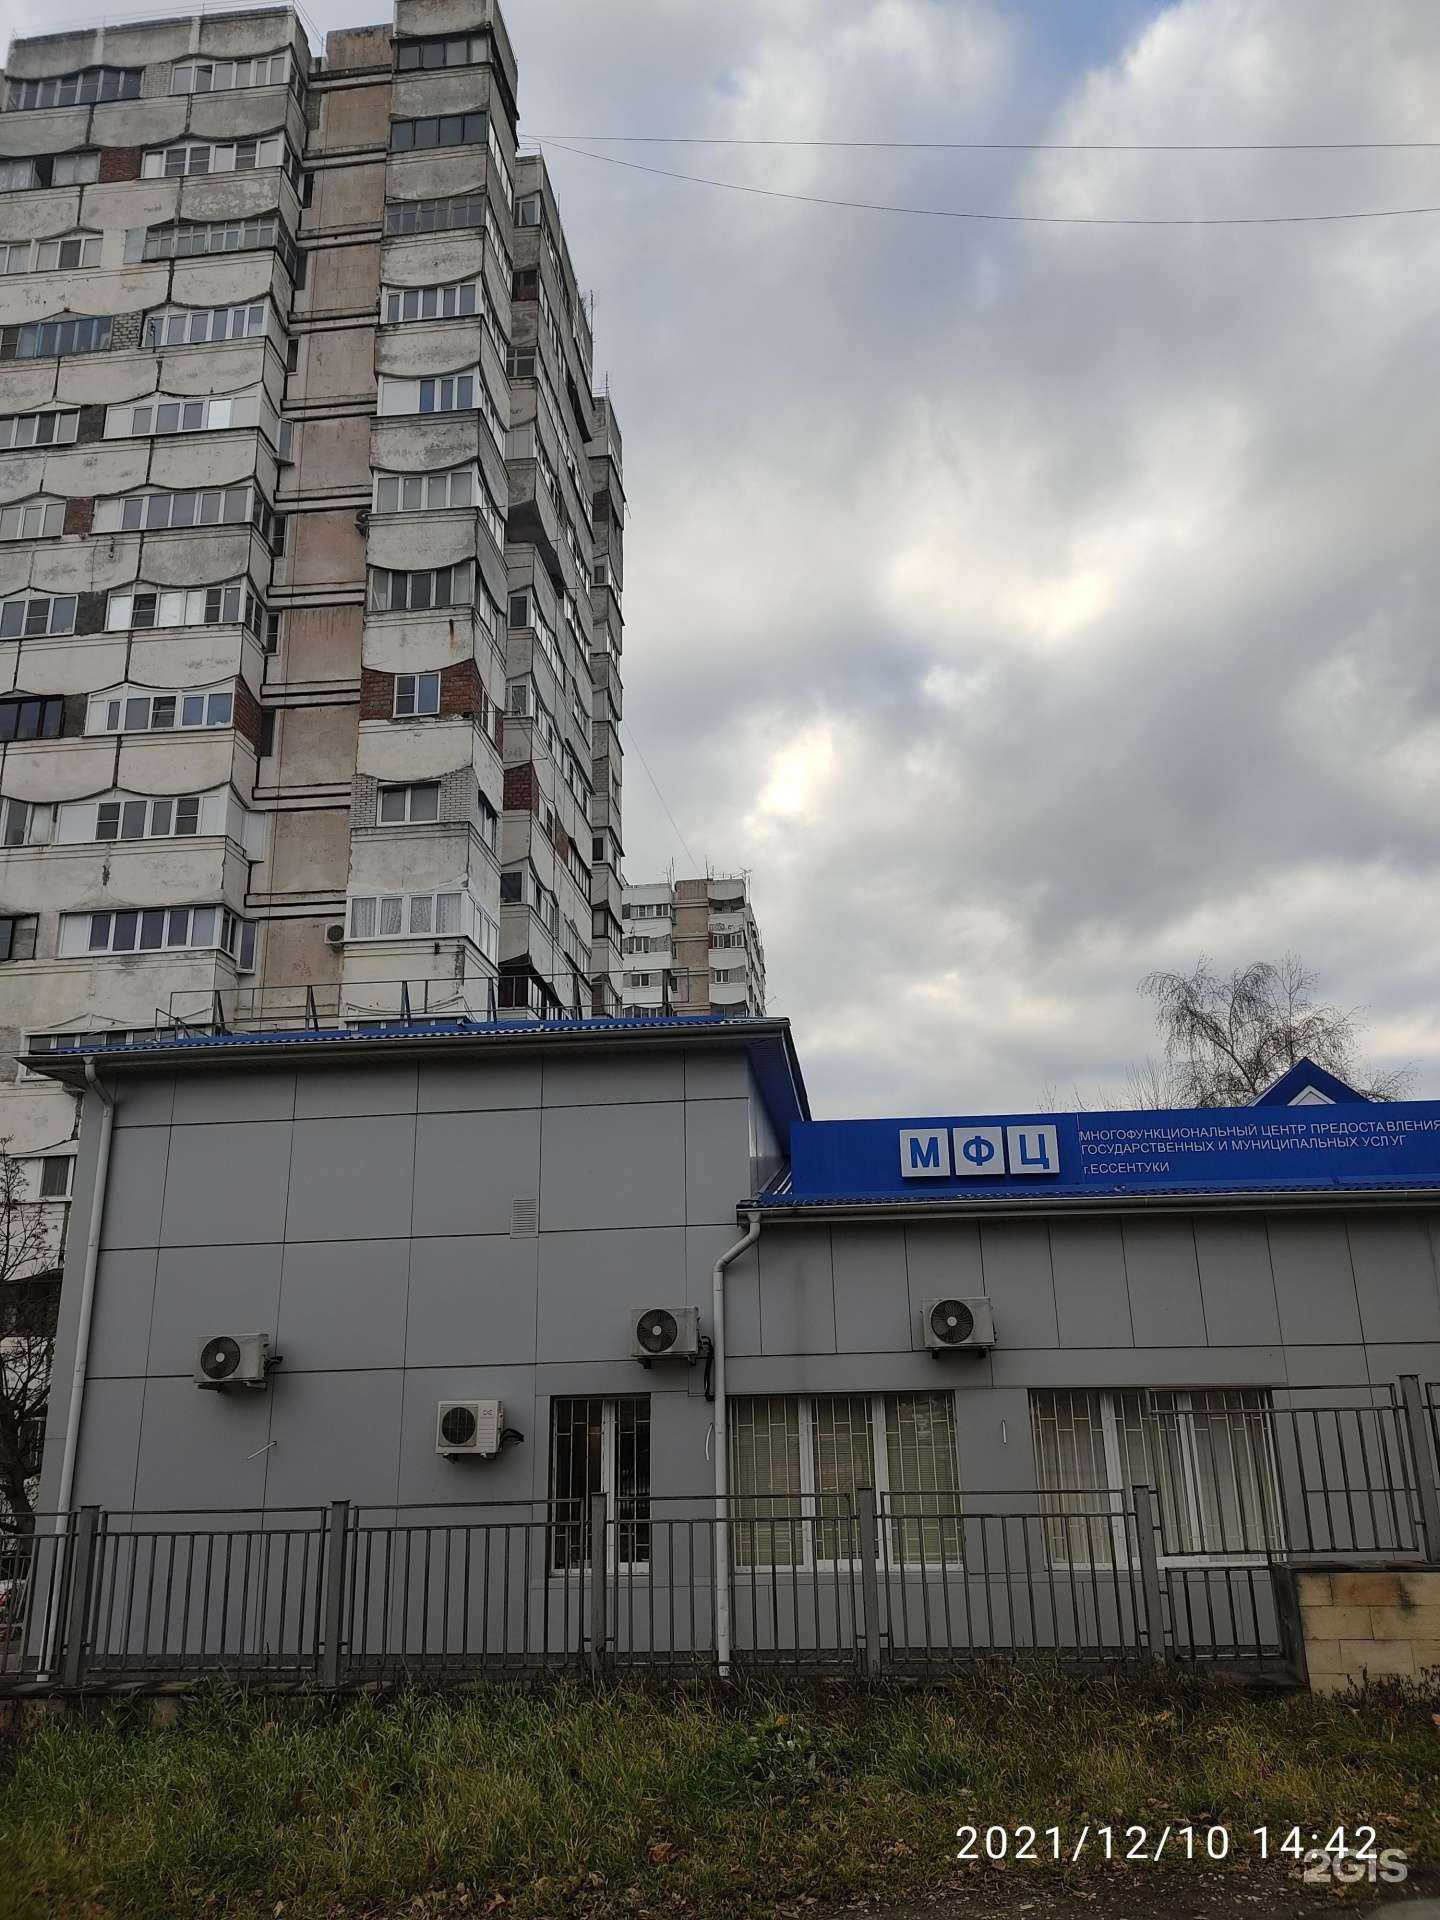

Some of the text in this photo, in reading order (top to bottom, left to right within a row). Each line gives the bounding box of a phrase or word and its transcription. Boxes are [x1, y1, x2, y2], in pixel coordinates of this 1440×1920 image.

[1080, 1120, 1440, 1141] МНОГОФУНКЦИОНАЛЬНЫЙ ЦЕНТР ПРЕДОСТАВЛЕНИЯ
[909, 1134, 1050, 1169] МФЦ
[1081, 1135, 1407, 1156] ГОСУДАРСТВЕННЫХ И МУНИЦИПАЛЬНЫХ УСЛУГ
[1084, 1162, 1170, 1175] г.ЕССЕНТУКИ
